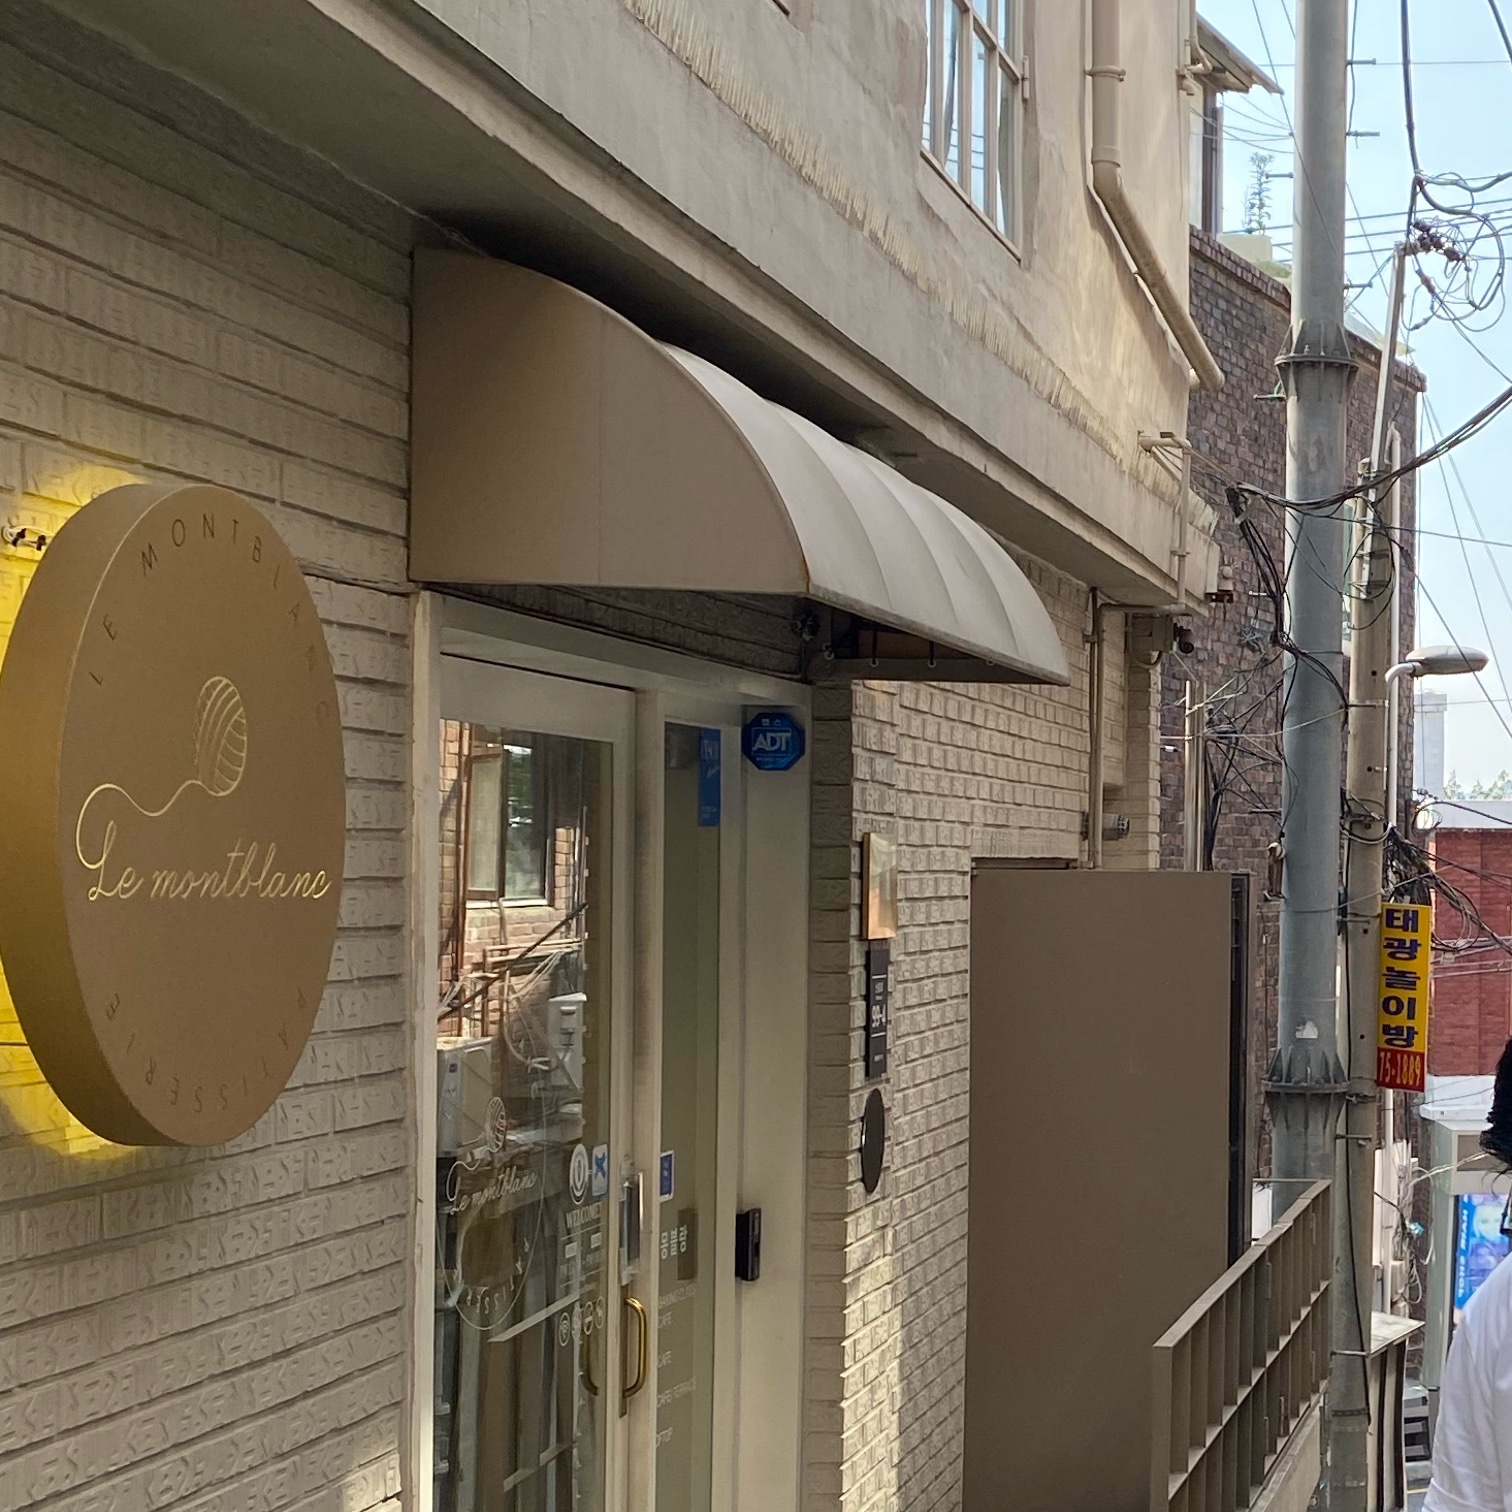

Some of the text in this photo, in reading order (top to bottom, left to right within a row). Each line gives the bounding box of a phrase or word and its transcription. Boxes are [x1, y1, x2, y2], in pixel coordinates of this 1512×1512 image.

[752, 731, 792, 751] ADT
[77, 818, 333, 901] Le montblanc
[1382, 908, 1422, 1049] 태광놀이방
